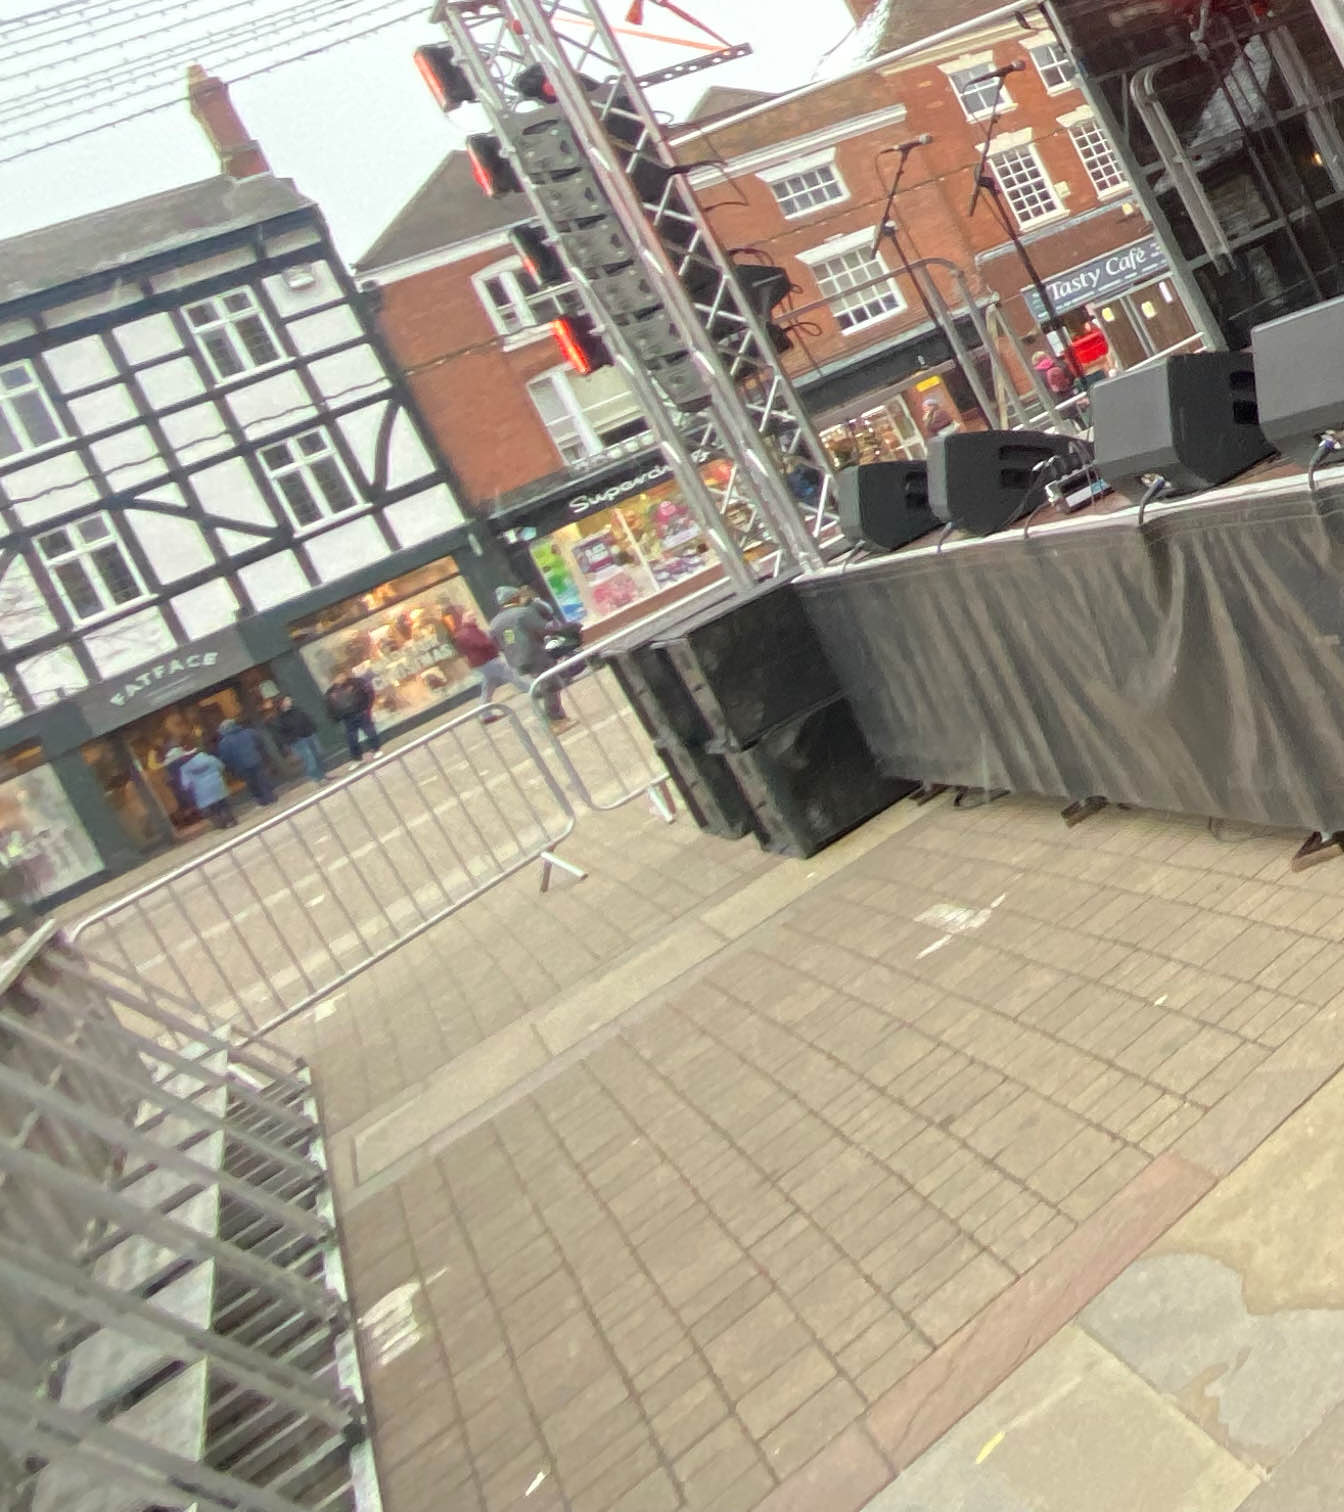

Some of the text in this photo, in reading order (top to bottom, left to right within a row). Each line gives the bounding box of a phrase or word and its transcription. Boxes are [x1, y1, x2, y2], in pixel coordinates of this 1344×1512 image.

[1047, 268, 1101, 301] Tasty
[1105, 248, 1147, 277] Café
[109, 652, 218, 706] FATFACE
